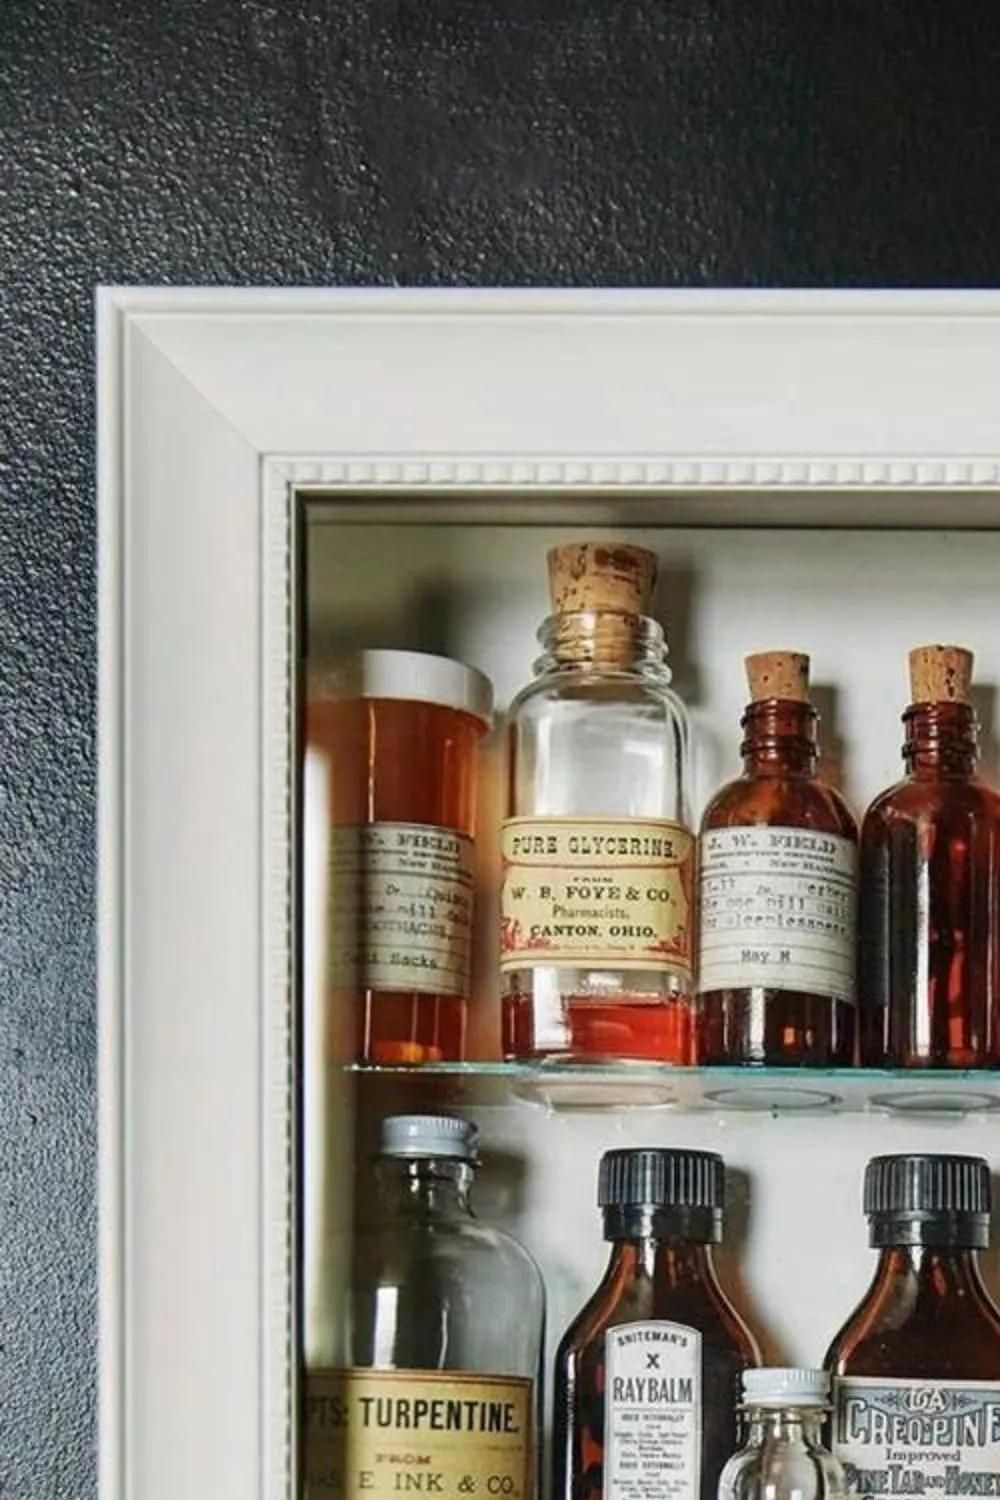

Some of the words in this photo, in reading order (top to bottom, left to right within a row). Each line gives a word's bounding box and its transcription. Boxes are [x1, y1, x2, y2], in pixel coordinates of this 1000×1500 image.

[512, 836, 558, 856] PURE
[768, 834, 837, 854] FIELD
[565, 886, 621, 901] FOYE
[625, 886, 641, 901] &
[645, 1352, 661, 1370] X
[612, 1376, 693, 1404] RAYBALM
[357, 1397, 521, 1434] TURPENTINE.
[374, 1452, 433, 1466] FROM
[885, 1450, 962, 1466] Improved
[393, 1472, 445, 1493] INK
[456, 1474, 478, 1494] &
